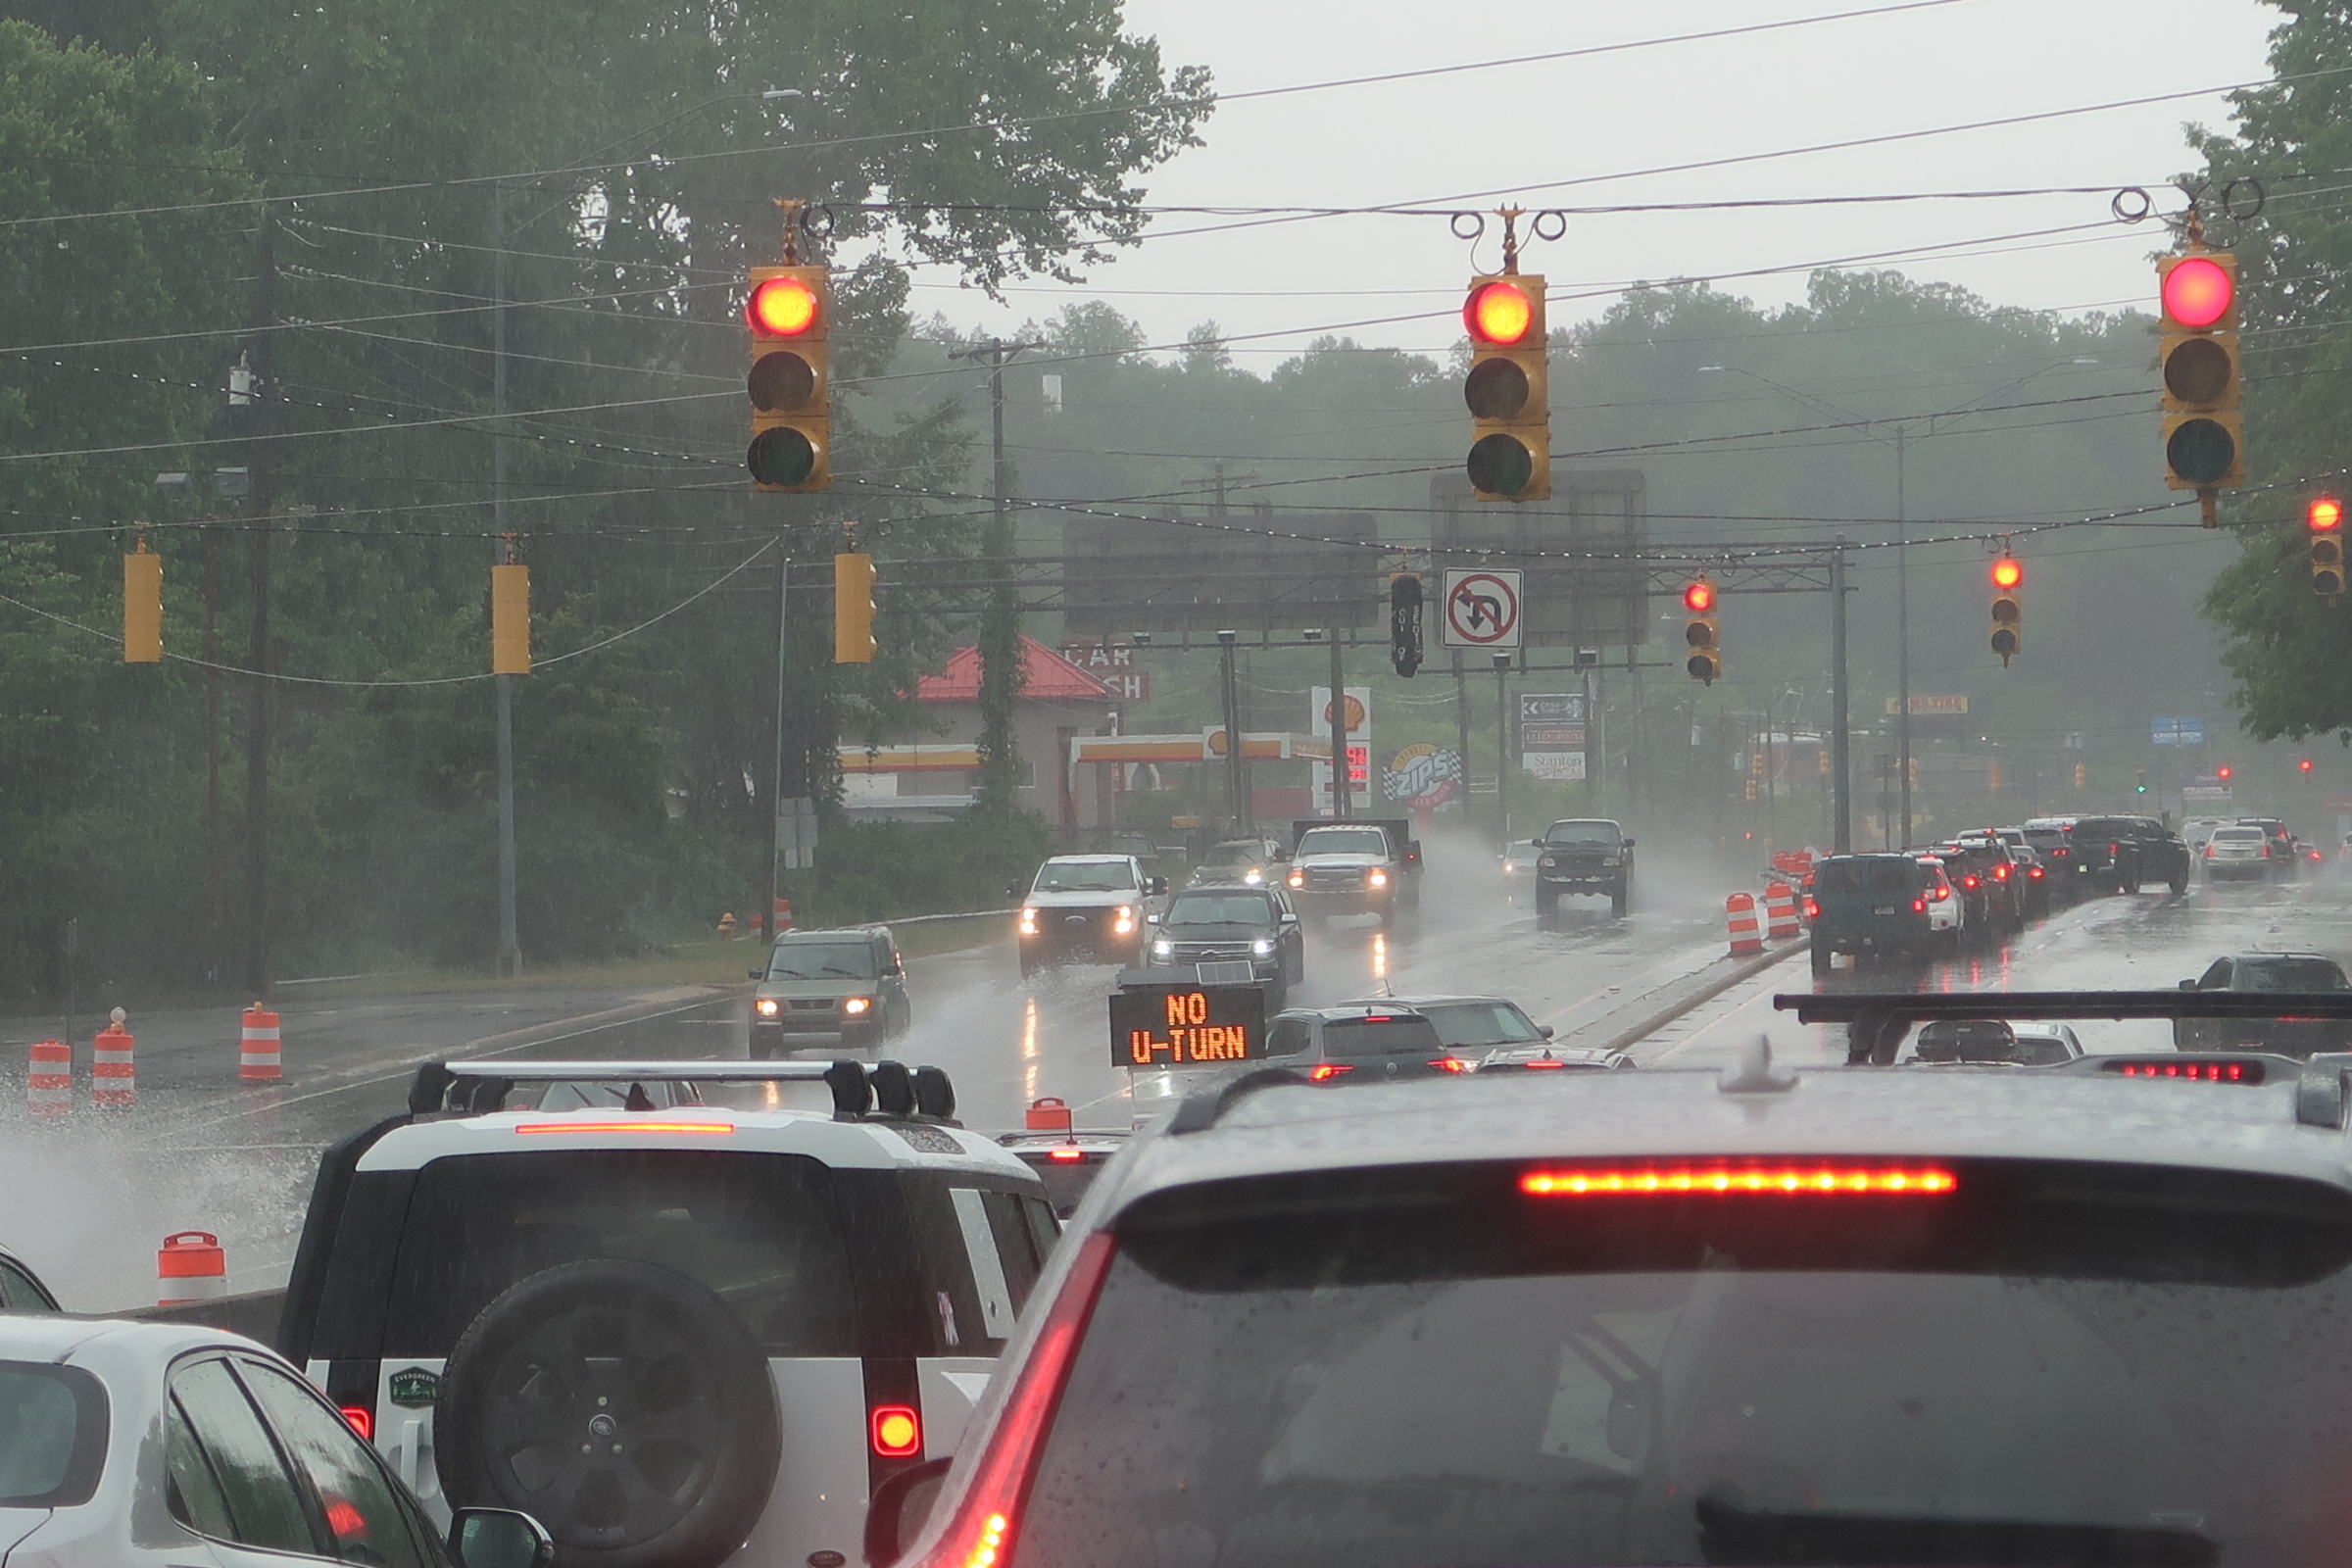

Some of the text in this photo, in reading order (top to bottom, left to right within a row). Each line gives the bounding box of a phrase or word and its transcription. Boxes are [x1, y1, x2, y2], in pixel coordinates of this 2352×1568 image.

[1064, 642, 1131, 666] CAR
[1535, 754, 1582, 766] Stanton
[1396, 753, 1449, 797] ZIPS
[1166, 992, 1207, 1026] NO
[1131, 1025, 1247, 1063] U-TURN
[394, 1373, 436, 1383] EVERGREEN
